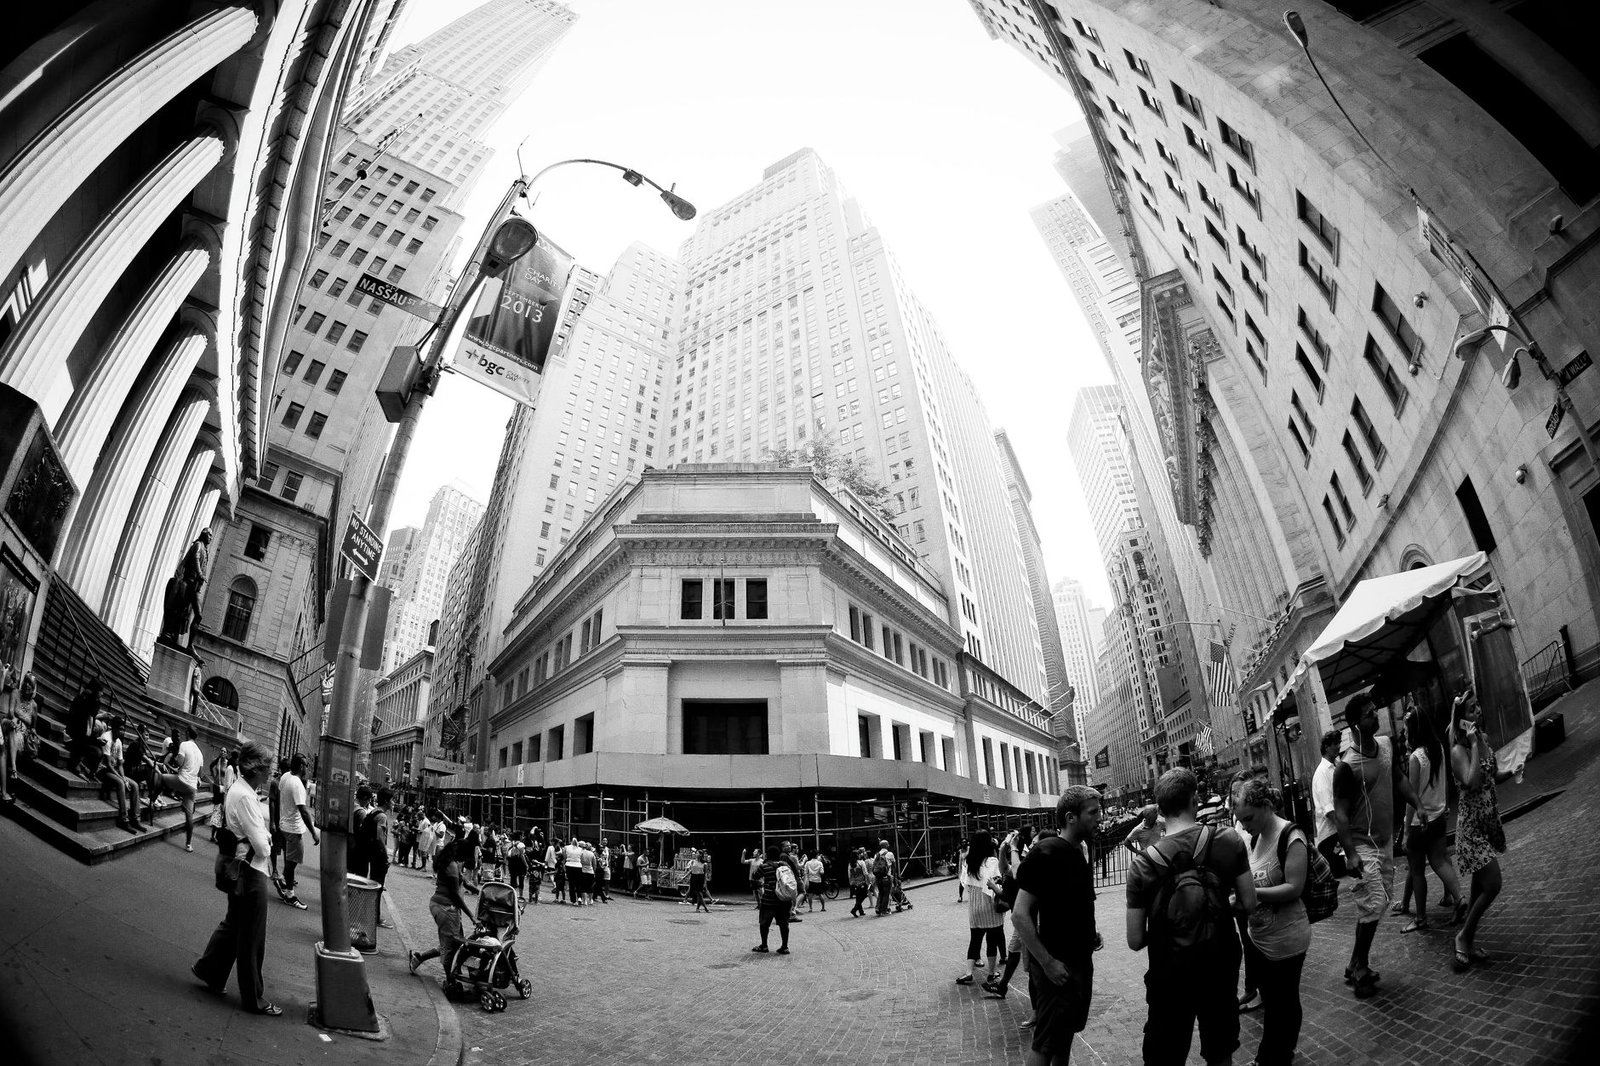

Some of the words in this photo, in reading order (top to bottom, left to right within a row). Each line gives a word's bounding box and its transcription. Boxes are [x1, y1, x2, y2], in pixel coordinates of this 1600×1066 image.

[359, 278, 408, 305] NASSAU
[407, 298, 417, 306] ST
[524, 272, 542, 284] DAY
[500, 295, 543, 323] 2013
[468, 333, 538, 371] www.bgcpartners.com
[477, 353, 505, 376] bgc
[1568, 357, 1587, 376] WALL
[350, 517, 360, 530] NO
[360, 526, 382, 554] STANDING
[351, 533, 376, 561] ANYTIME
